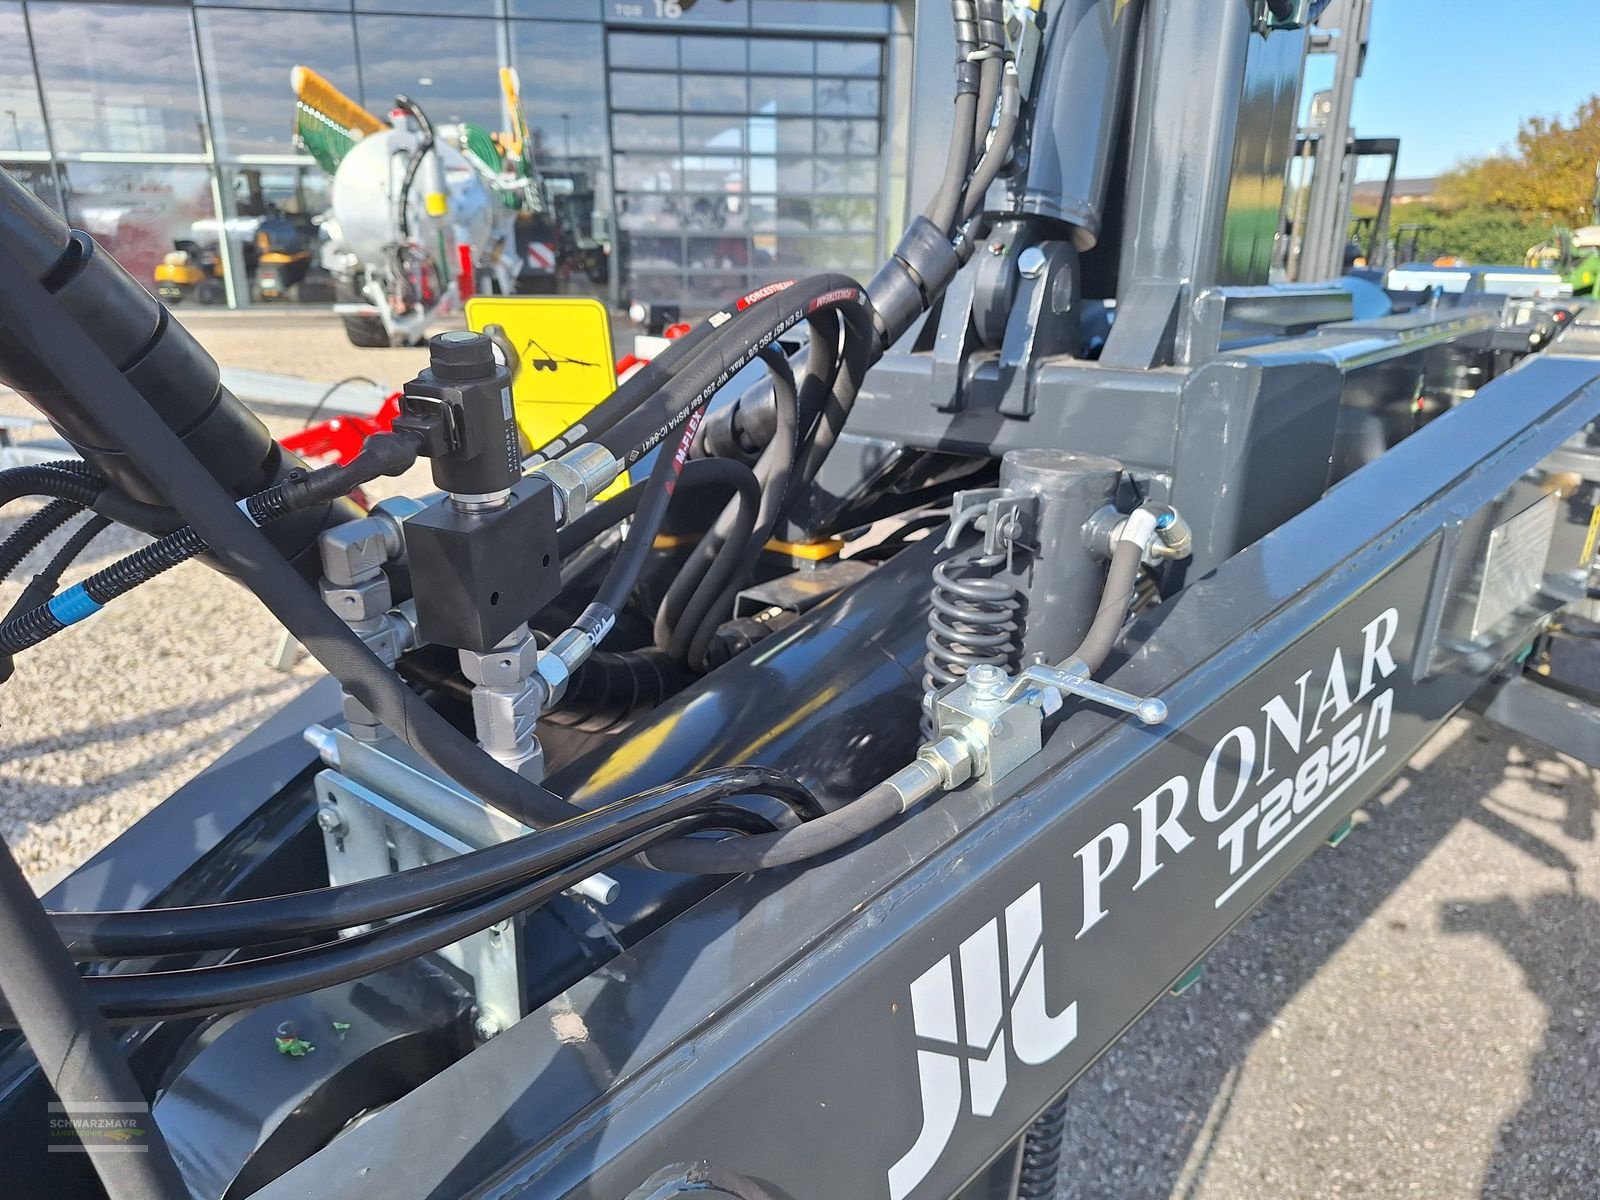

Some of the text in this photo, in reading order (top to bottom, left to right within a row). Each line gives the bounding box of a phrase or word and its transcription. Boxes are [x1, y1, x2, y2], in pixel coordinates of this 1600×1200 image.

[654, 0, 682, 19] 16
[774, 322, 785, 335] 657
[784, 315, 795, 327] EN
[729, 356, 745, 373] Max.
[716, 370, 729, 387] WP
[703, 382, 716, 398] 250
[690, 393, 703, 408] Bar
[668, 407, 690, 431] MSHA
[675, 410, 702, 465] M-FLEX
[1073, 607, 1399, 940] PRONAR
[1217, 688, 1394, 876] T285/1
